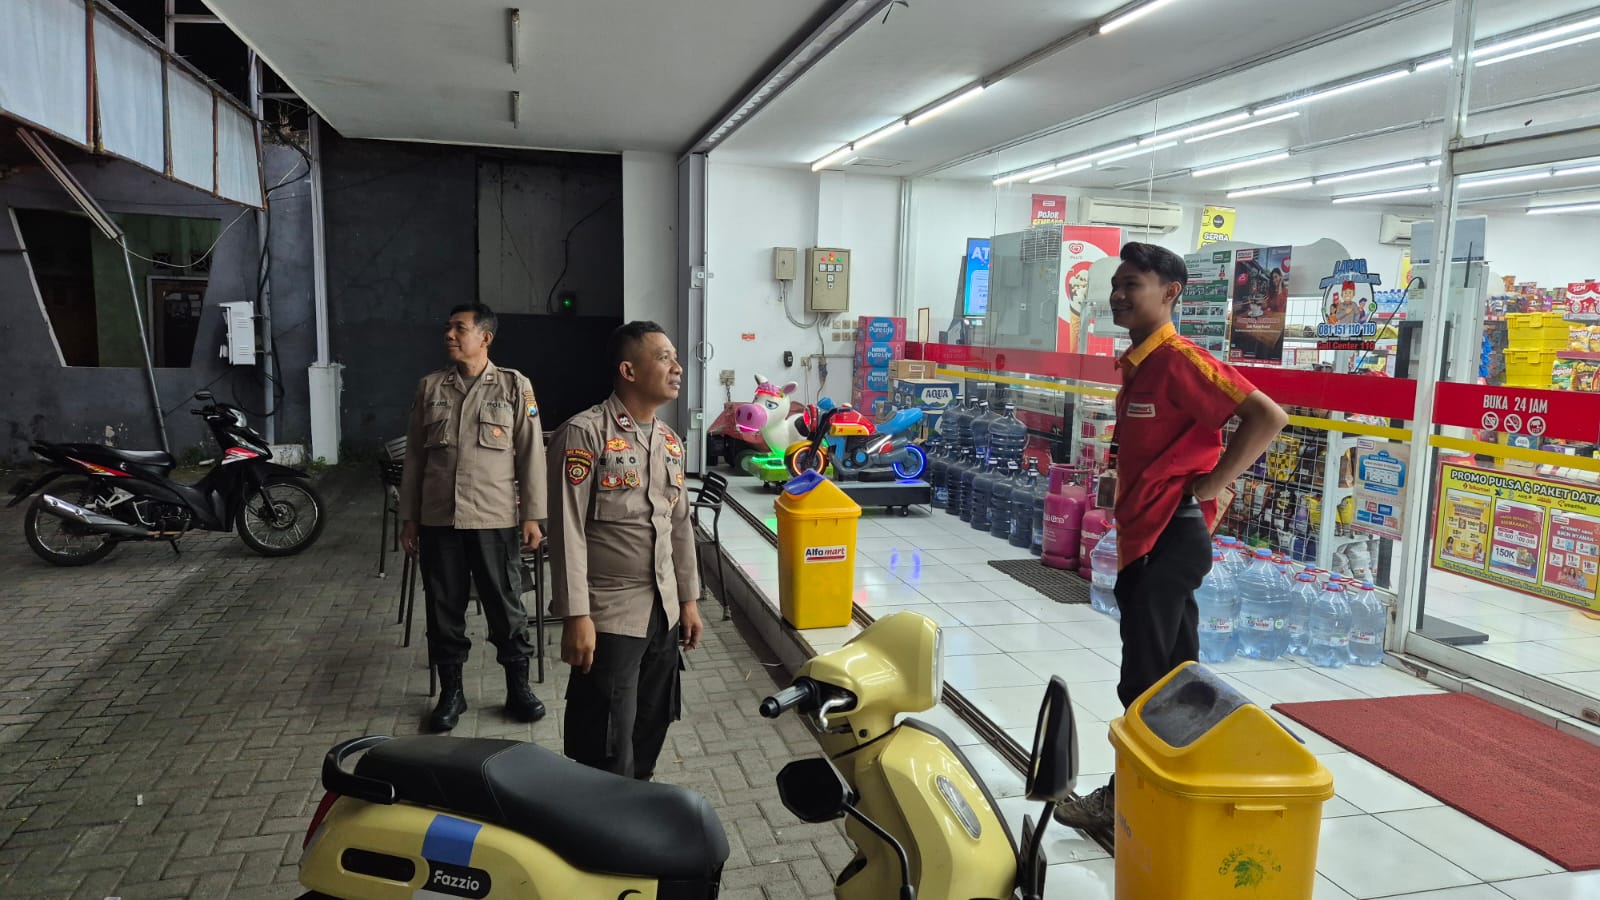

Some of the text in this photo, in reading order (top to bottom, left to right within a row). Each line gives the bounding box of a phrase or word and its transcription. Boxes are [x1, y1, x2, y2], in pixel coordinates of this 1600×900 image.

[1203, 232, 1229, 241] SERBA
[971, 247, 990, 260] AT
[1319, 324, 1375, 335] 081 151 110 110
[925, 389, 949, 399] AQUA
[1483, 394, 1548, 414] BUKA 24 JAM
[1451, 470, 1600, 506] PROMO PULSA & PAKET DATA
[1495, 546, 1515, 560] 150K
[433, 870, 480, 891] Fazzio
